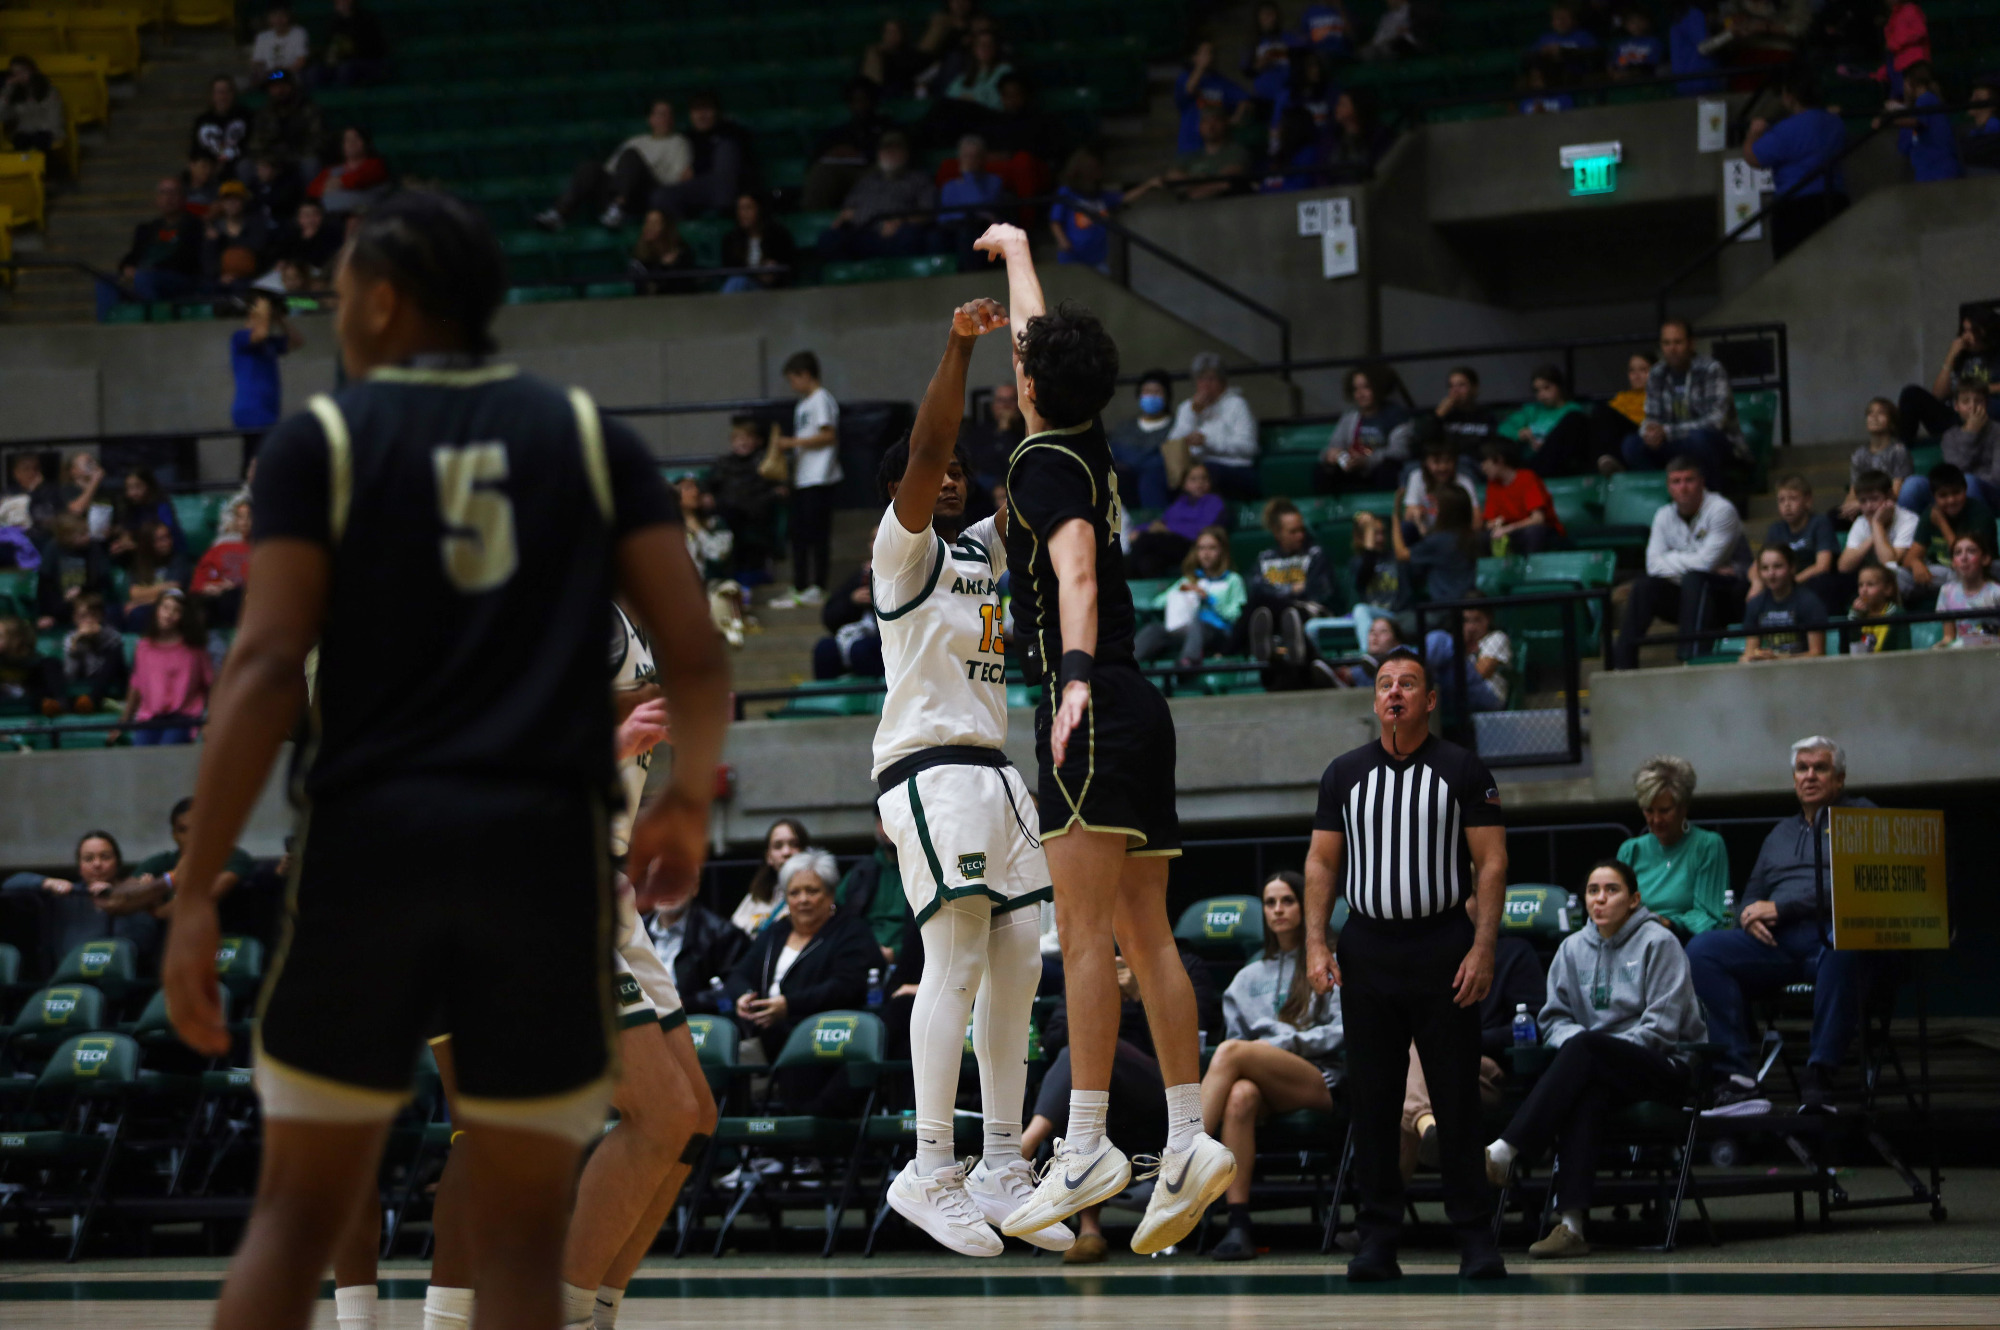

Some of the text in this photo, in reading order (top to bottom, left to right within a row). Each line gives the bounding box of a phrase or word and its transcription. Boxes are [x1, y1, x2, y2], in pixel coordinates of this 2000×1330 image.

[431, 439, 520, 595] 5
[1835, 815, 1940, 855] FIGHT ON SOCIETY
[959, 860, 986, 873] TECH
[1854, 865, 1926, 892] MEMBER SEATING
[1505, 901, 1540, 914] TECH
[1206, 912, 1240, 925] TECH
[82, 952, 111, 964] TECH
[45, 1000, 76, 1012] TECH
[814, 1028, 851, 1042] TECH
[76, 1050, 108, 1062] TECH
[749, 1121, 775, 1132] TECH
[2, 1136, 25, 1146] TECH
